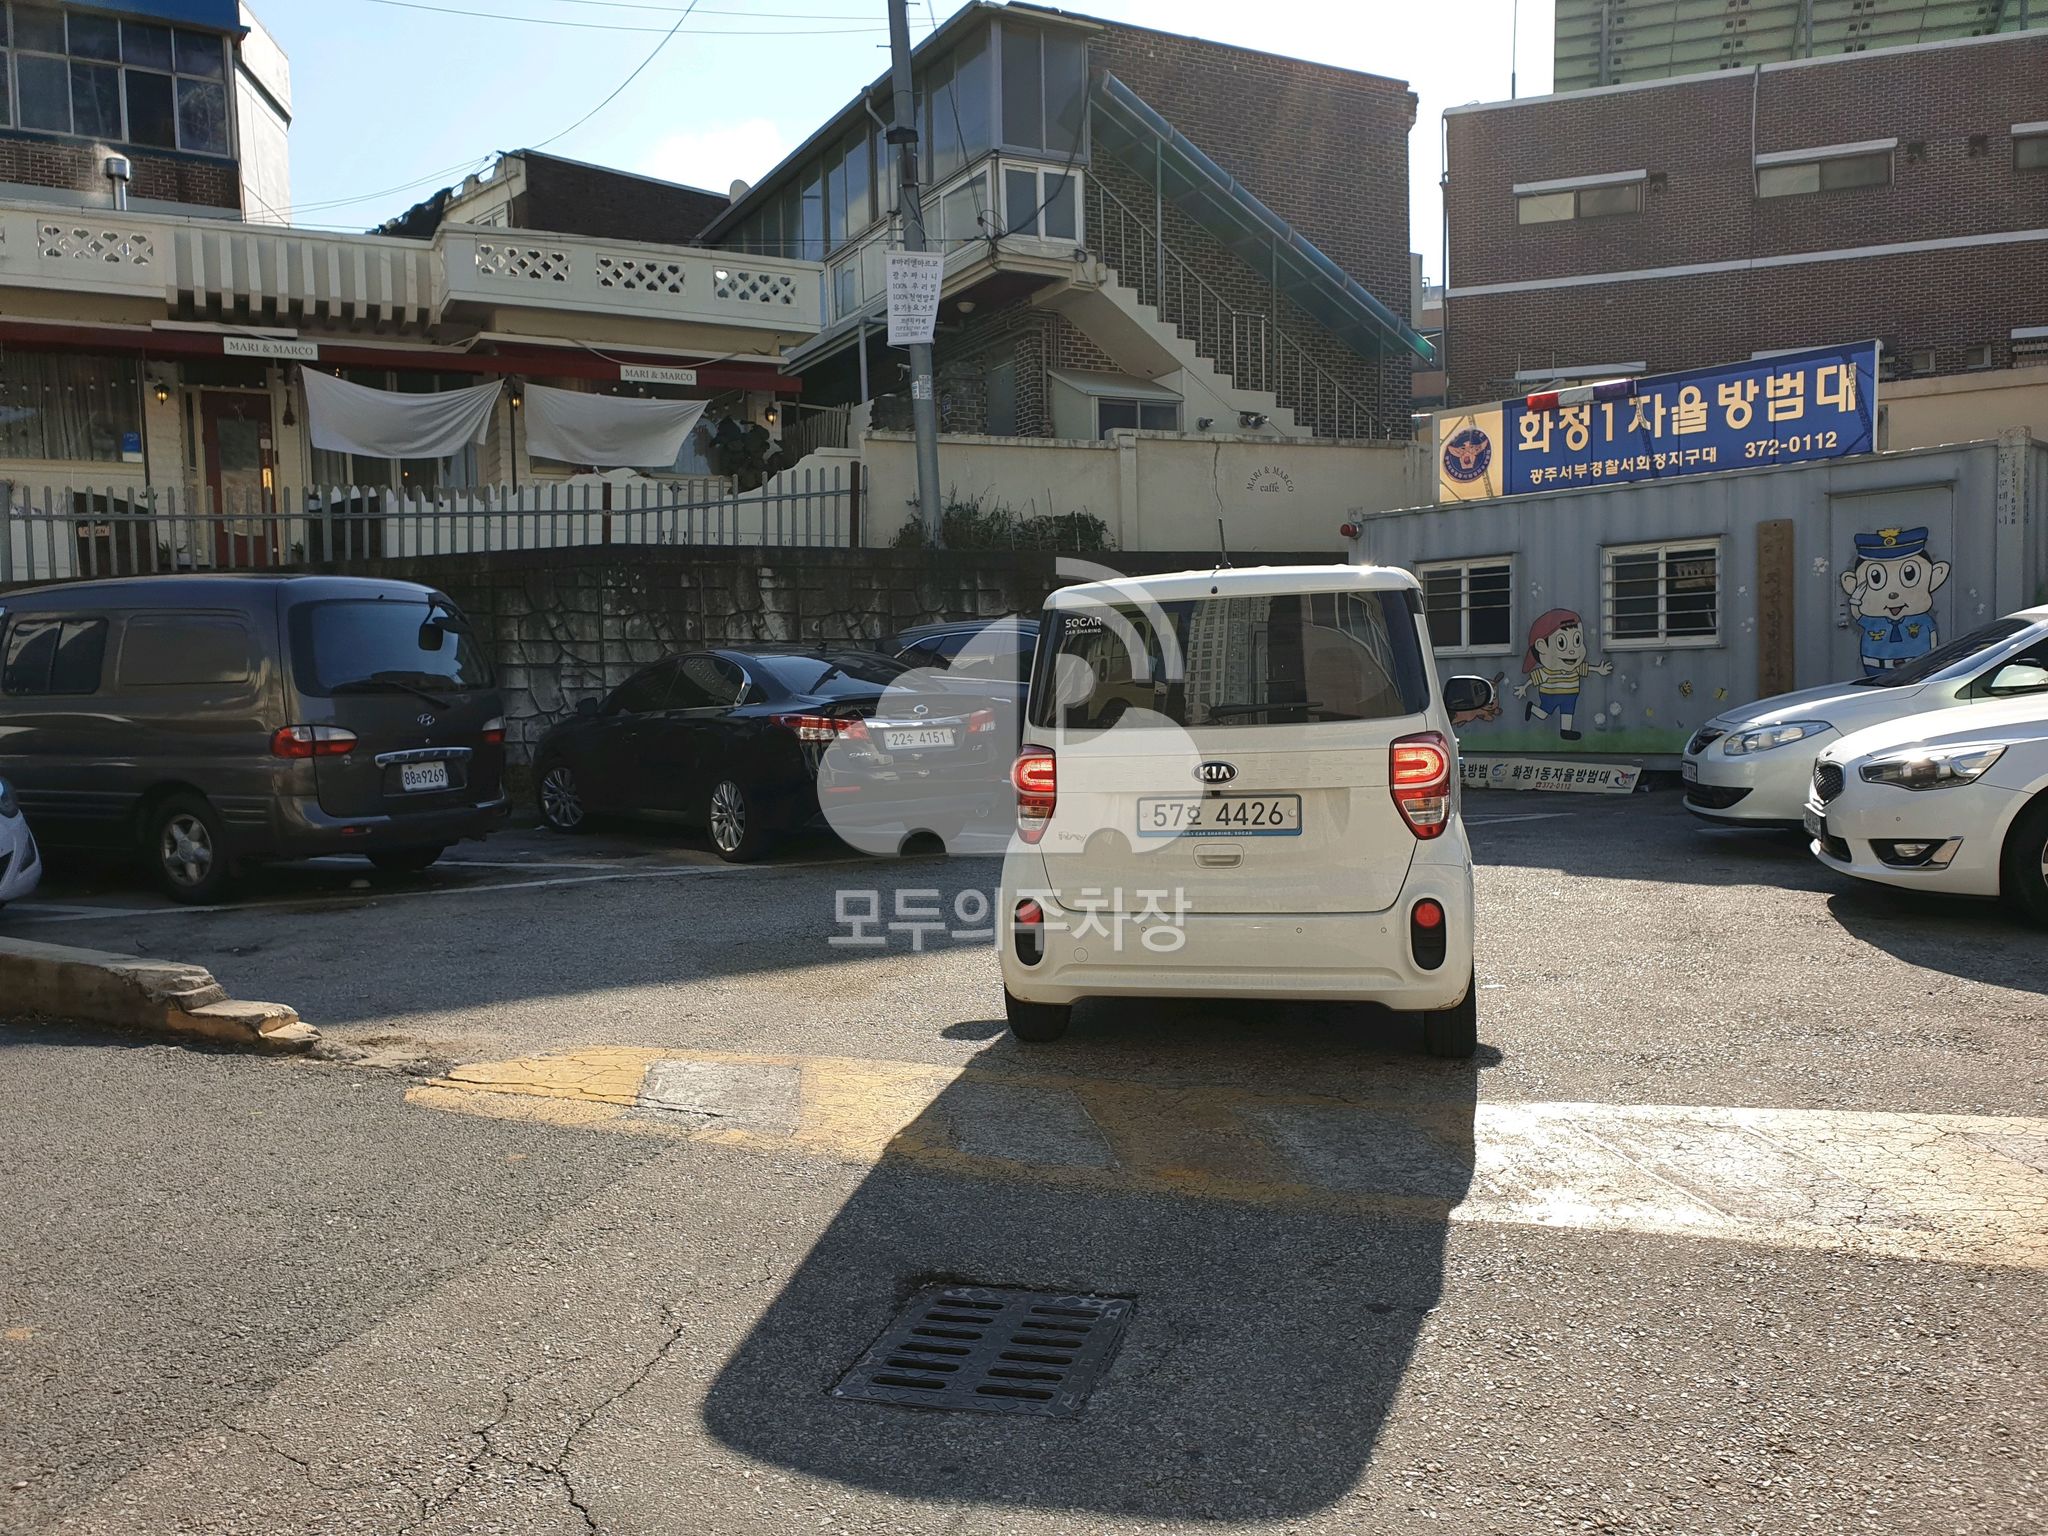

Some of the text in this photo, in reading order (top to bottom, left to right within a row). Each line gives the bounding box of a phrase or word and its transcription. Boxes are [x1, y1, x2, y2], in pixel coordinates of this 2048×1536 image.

[229, 341, 314, 356] MARI & MARCO
[625, 368, 649, 379] MARI
[660, 372, 693, 382] MARCO
[1744, 430, 1838, 458] 372-0112
[1065, 616, 1102, 629] SOCAR
[919, 730, 946, 745] 4151
[1200, 765, 1231, 780] KIA
[1153, 801, 1284, 827] 57호 4426
